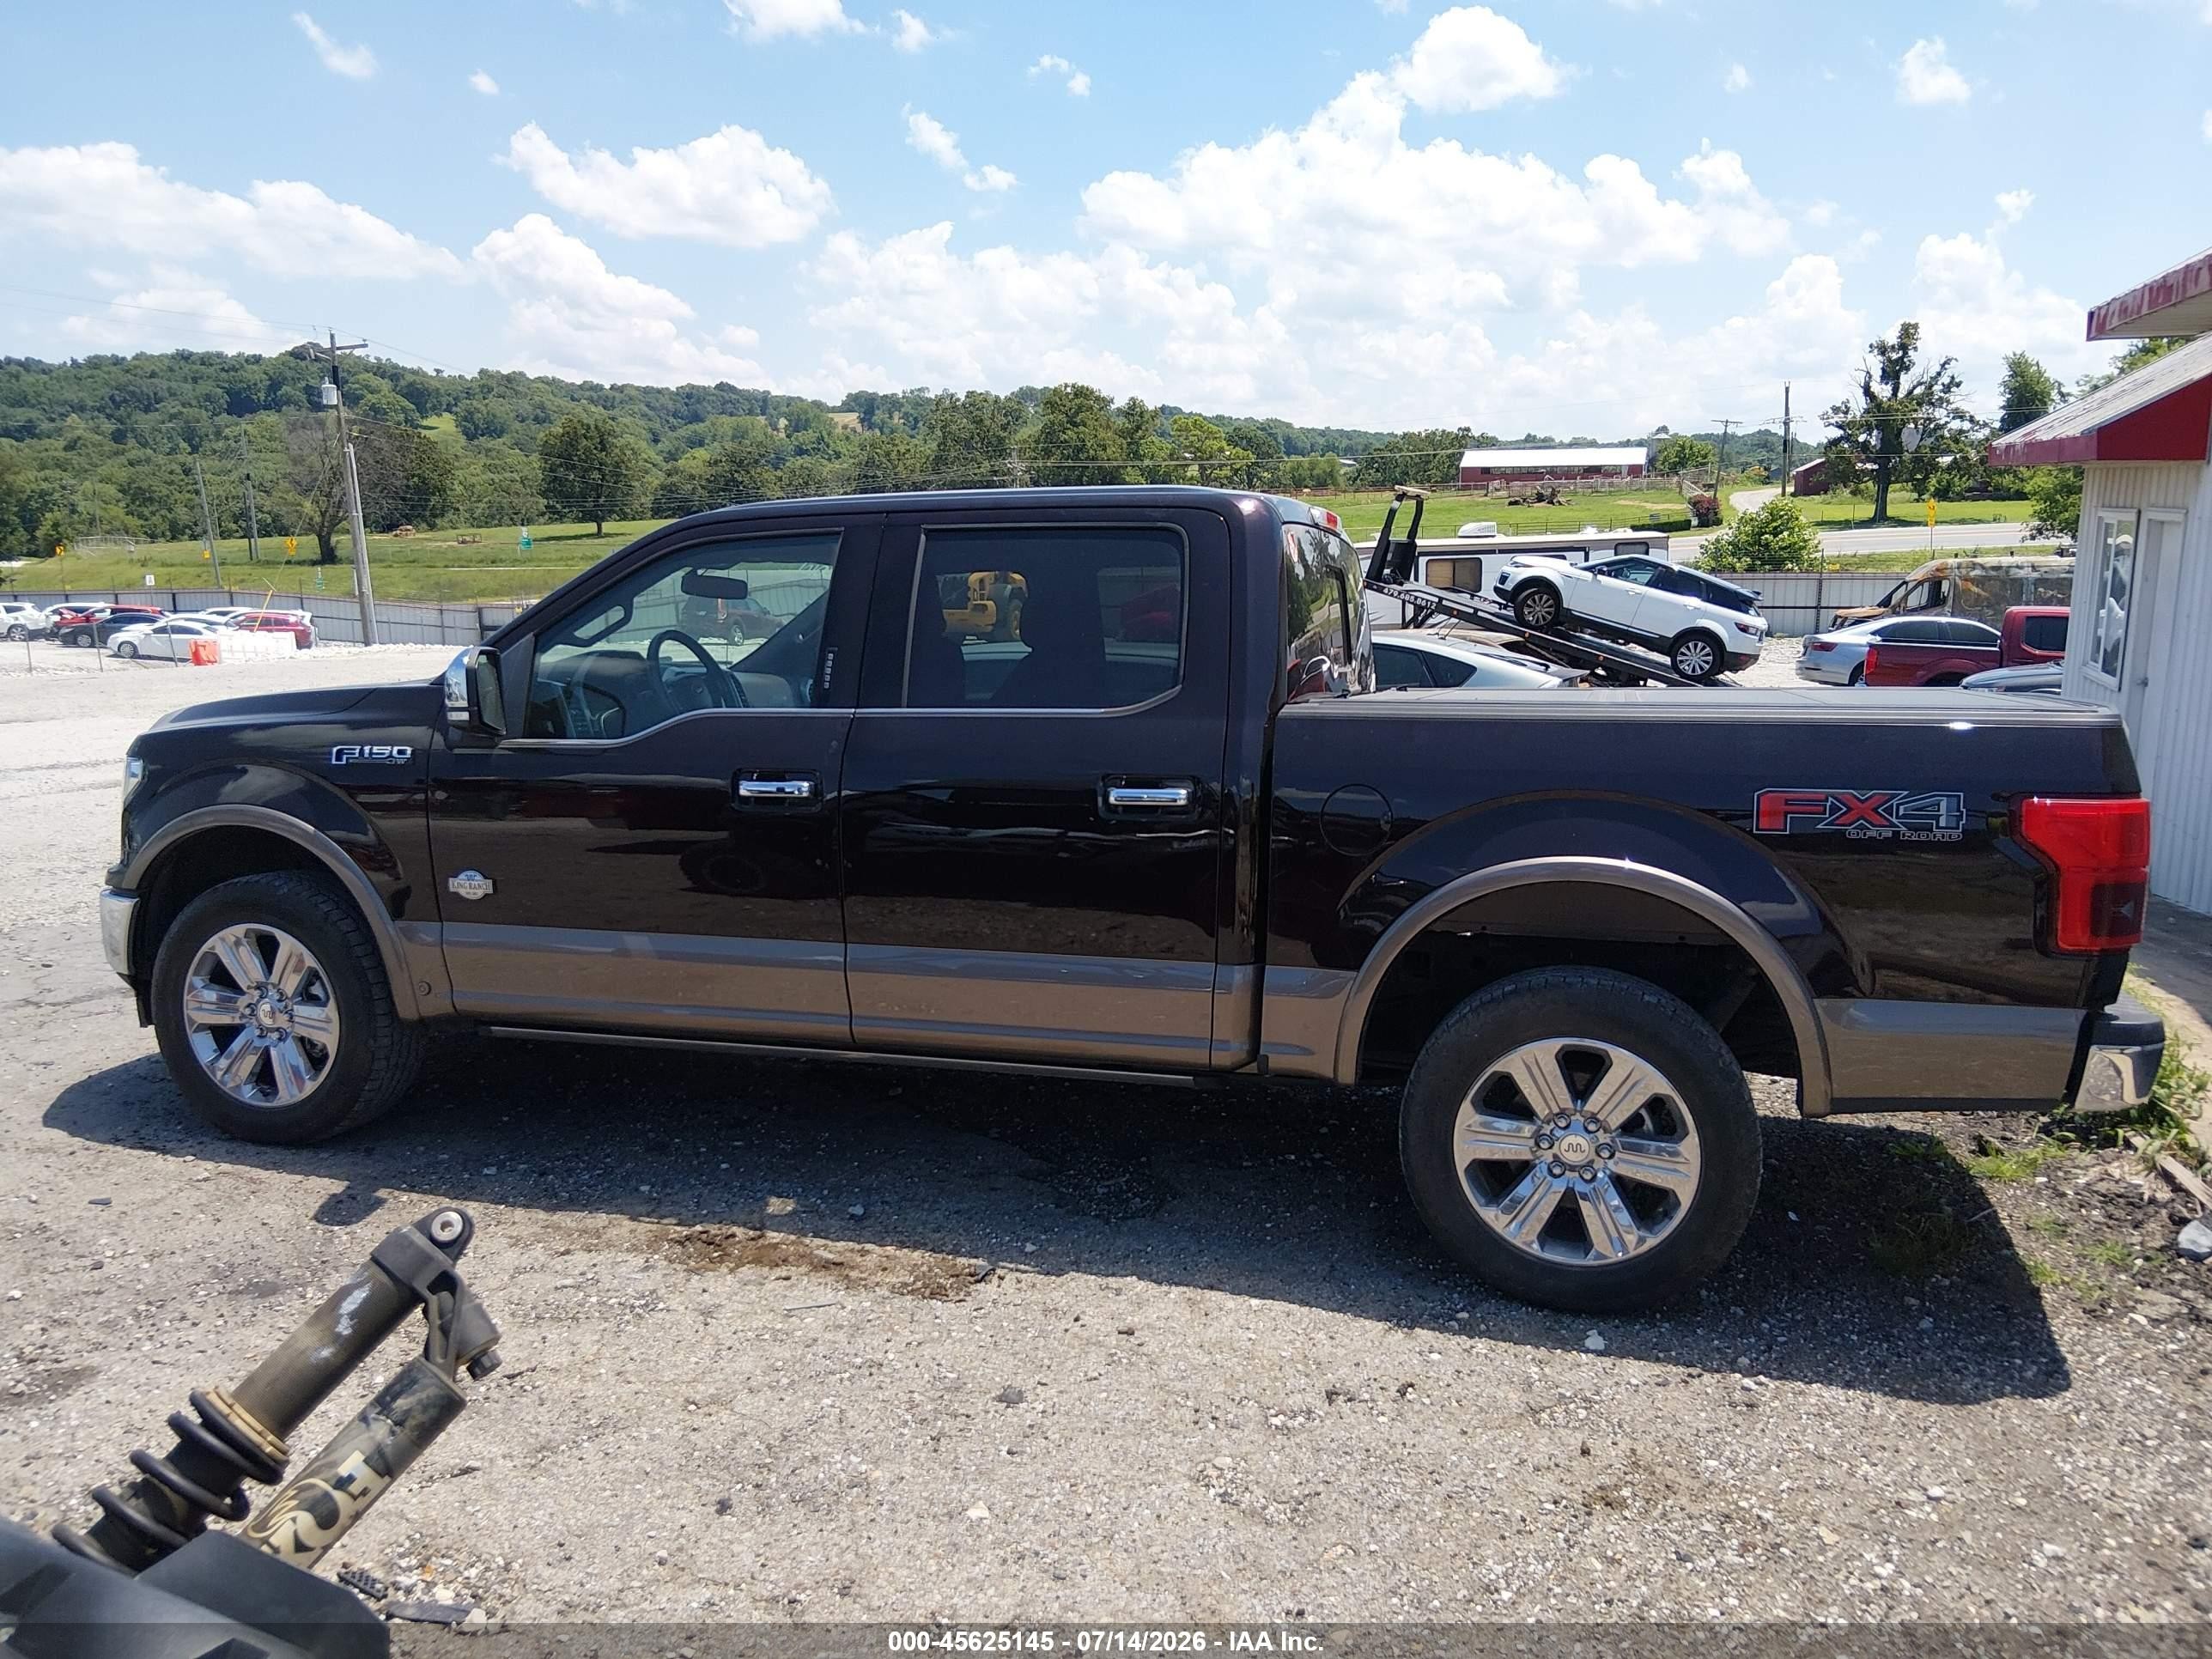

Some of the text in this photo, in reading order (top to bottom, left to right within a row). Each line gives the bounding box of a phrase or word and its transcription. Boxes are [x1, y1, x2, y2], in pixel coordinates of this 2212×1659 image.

[1753, 788, 1966, 834] FX4
[1846, 830, 1963, 841] OFF ROAD
[452, 879, 491, 890] KING RANCH
